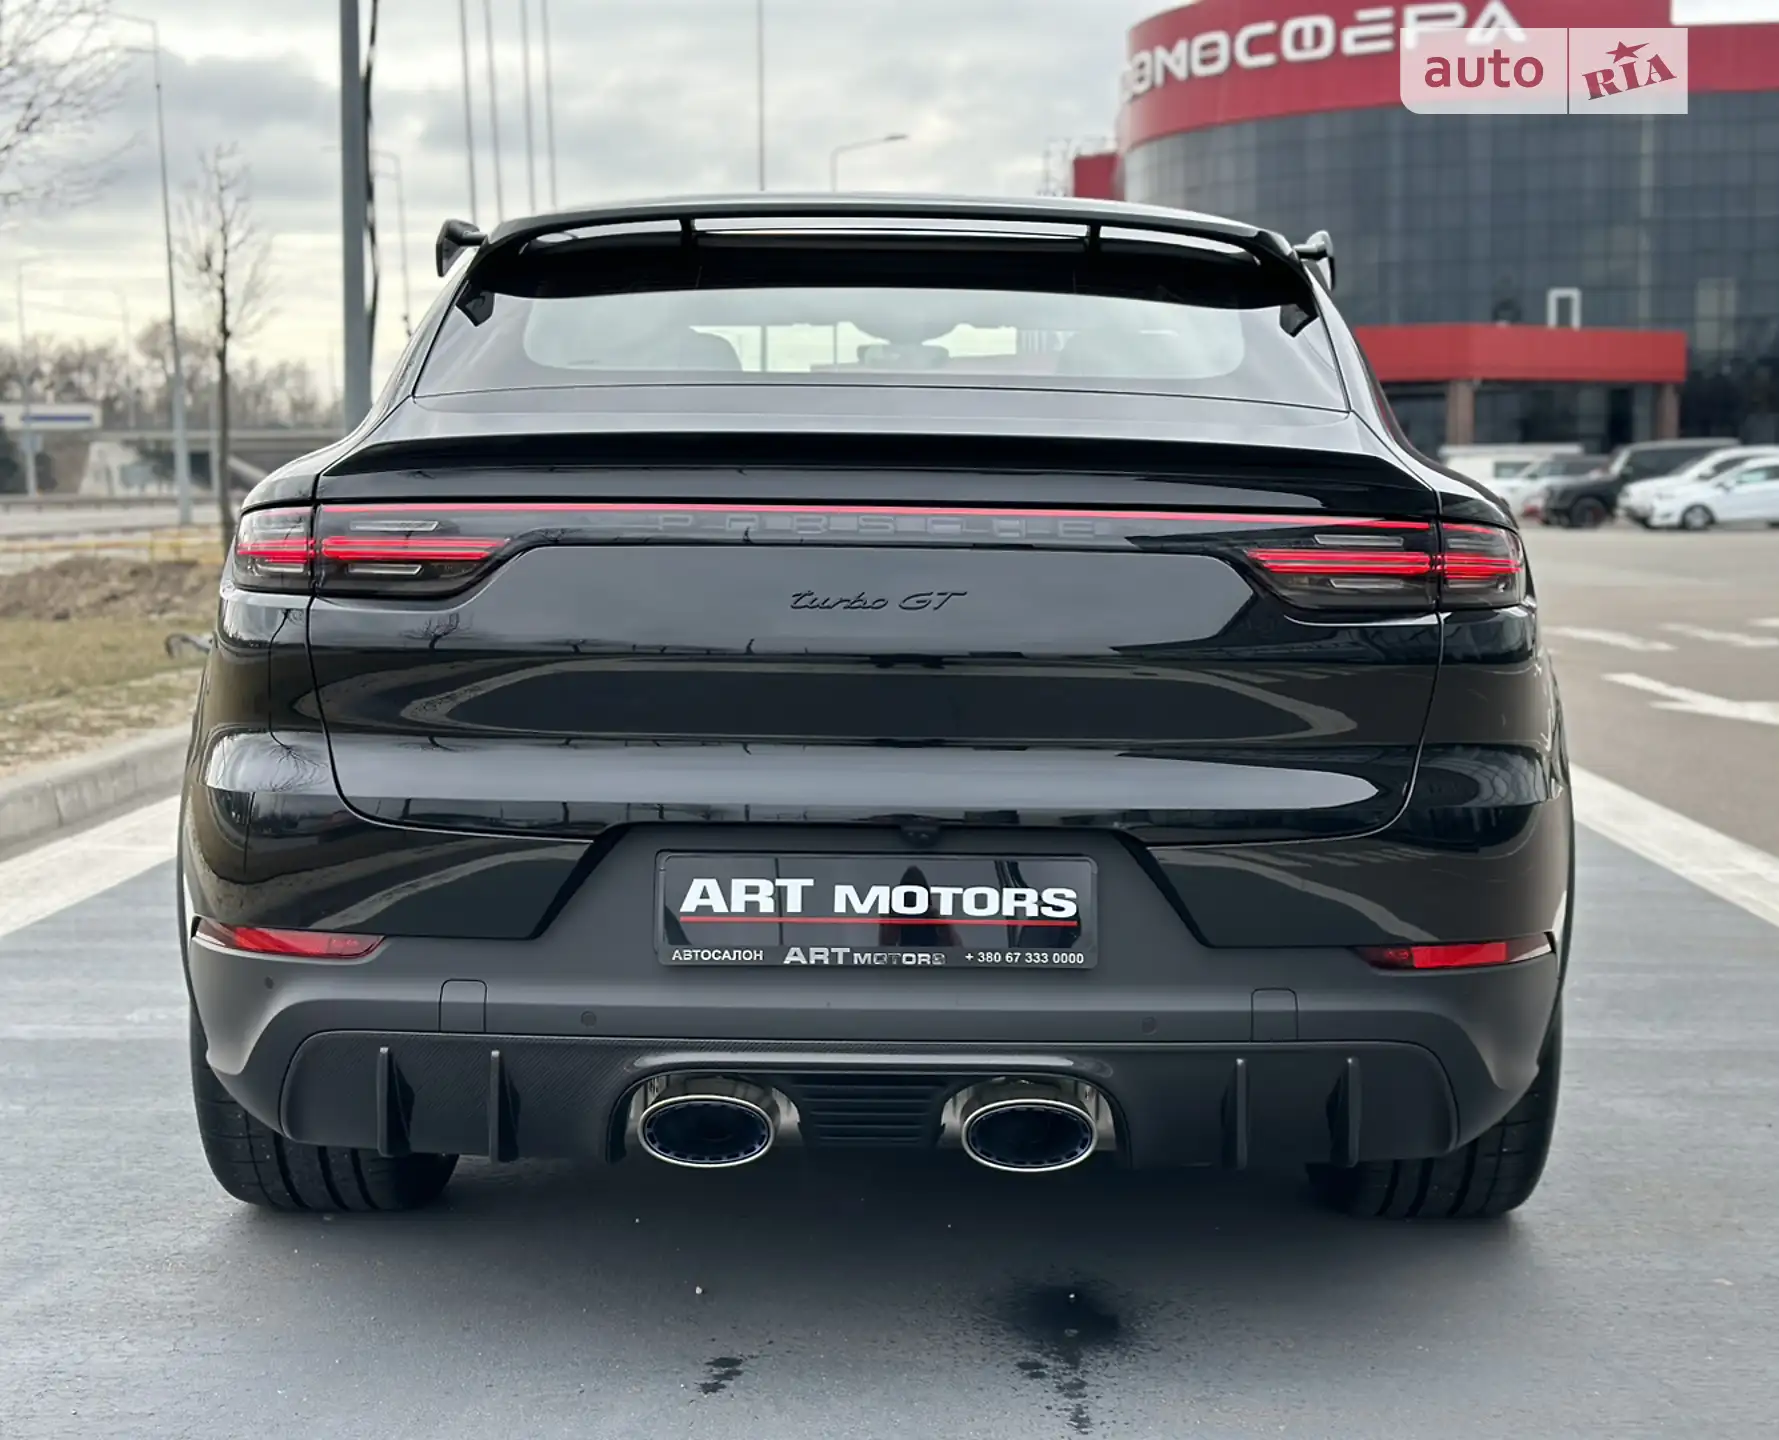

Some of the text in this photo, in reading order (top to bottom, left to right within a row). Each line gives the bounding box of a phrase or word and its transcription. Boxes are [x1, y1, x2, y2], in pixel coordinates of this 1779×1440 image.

[790, 590, 968, 610] turbo GT
[679, 878, 1078, 918] ART MOTORS
[671, 949, 764, 961] АВТОСАЛОН
[783, 947, 947, 965] ART MOTORS
[1005, 952, 1021, 964] 67
[1024, 953, 1049, 964] 333
[1052, 953, 1085, 965] 0000
